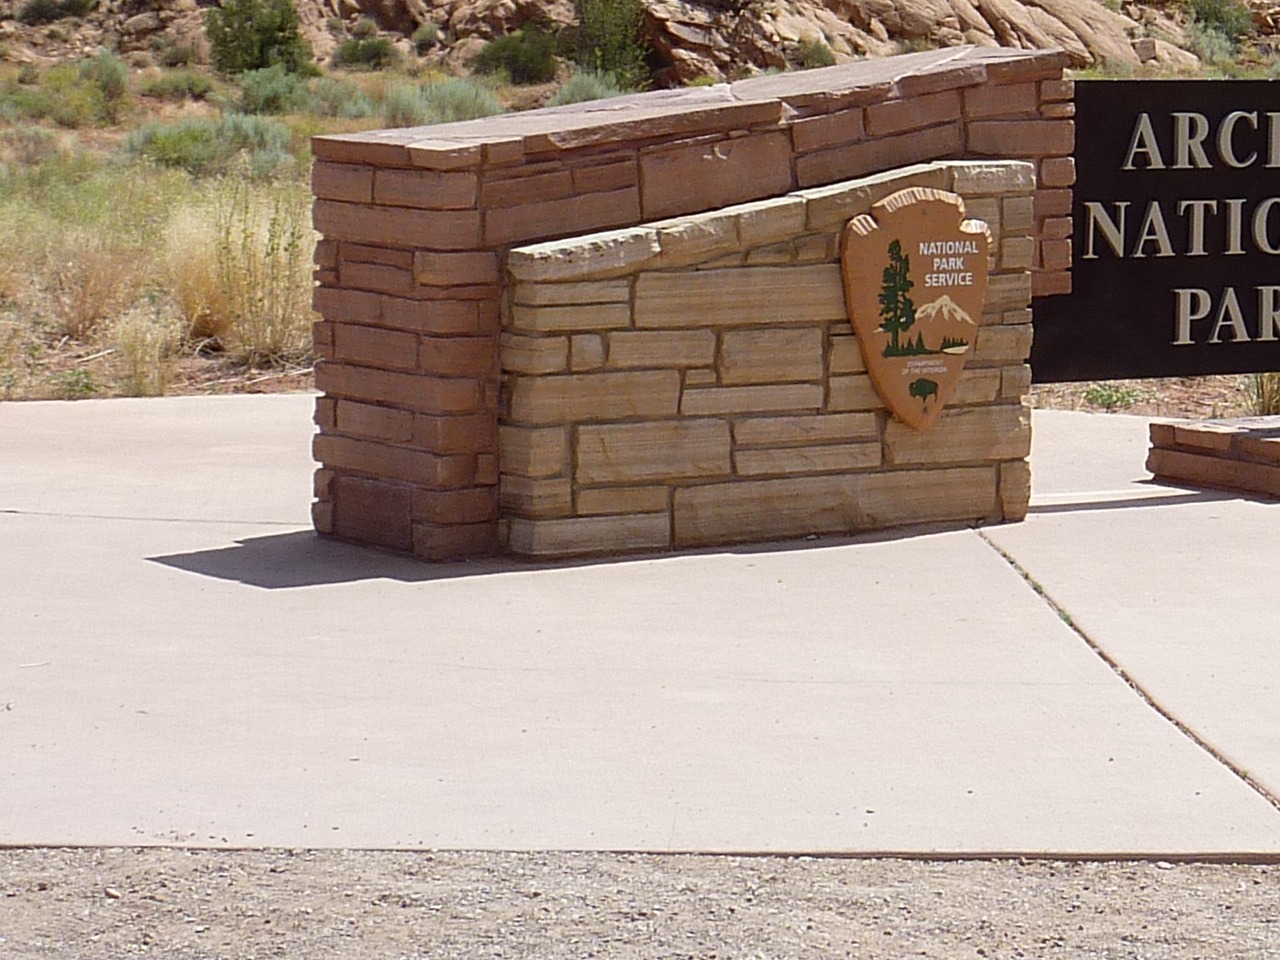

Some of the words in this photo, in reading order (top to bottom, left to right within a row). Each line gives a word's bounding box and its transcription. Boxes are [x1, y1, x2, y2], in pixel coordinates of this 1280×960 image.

[919, 241, 979, 256] NATIONAL
[933, 257, 964, 270] PARK
[924, 272, 973, 287] SERVICE
